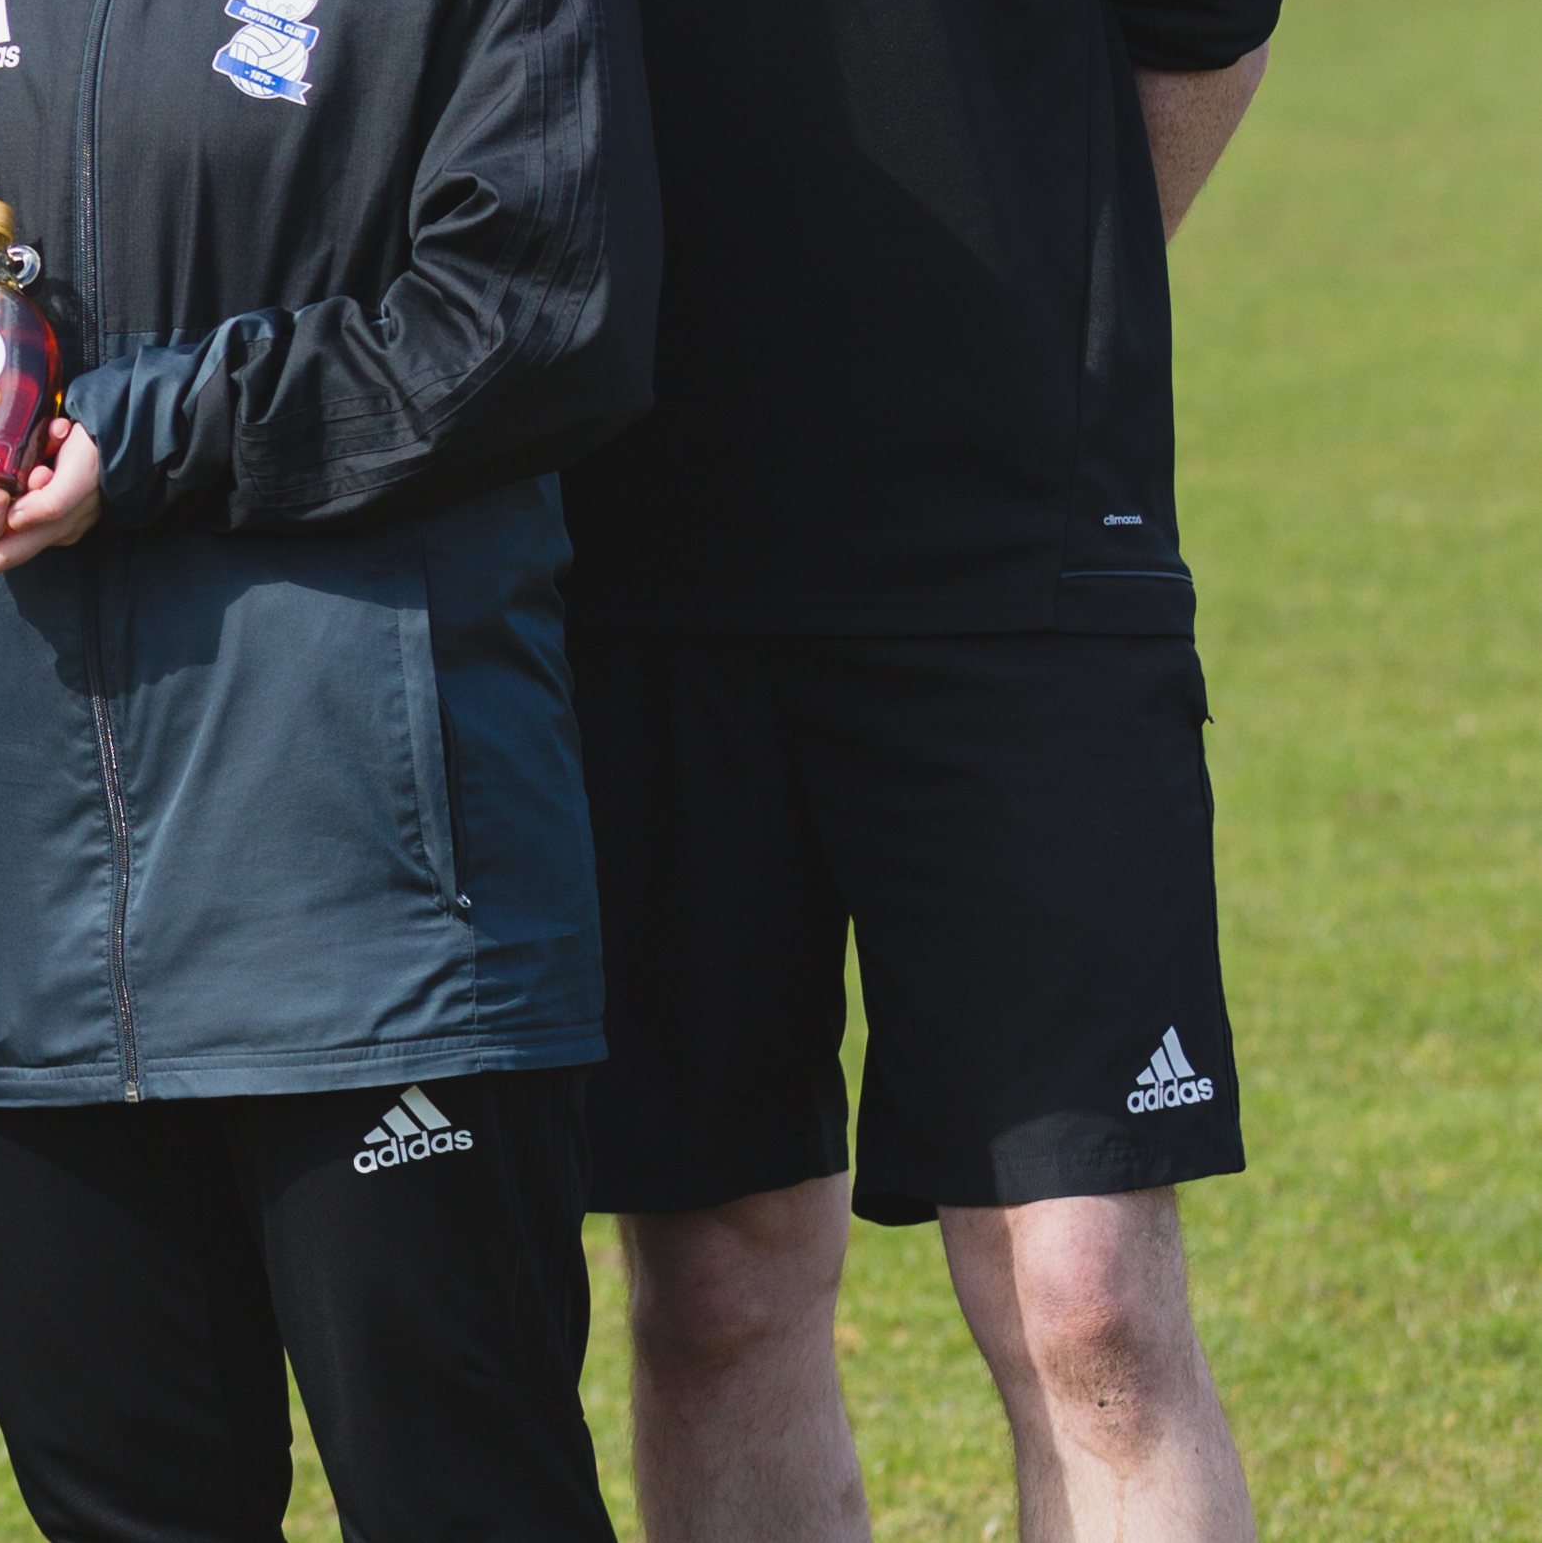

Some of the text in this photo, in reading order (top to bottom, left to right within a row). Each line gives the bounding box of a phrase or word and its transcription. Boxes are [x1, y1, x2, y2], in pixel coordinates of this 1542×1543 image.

[239, 7, 308, 40] FOOTBALL CLUB
[1126, 1077, 1214, 1114] adidas
[353, 1124, 474, 1174] adidas
